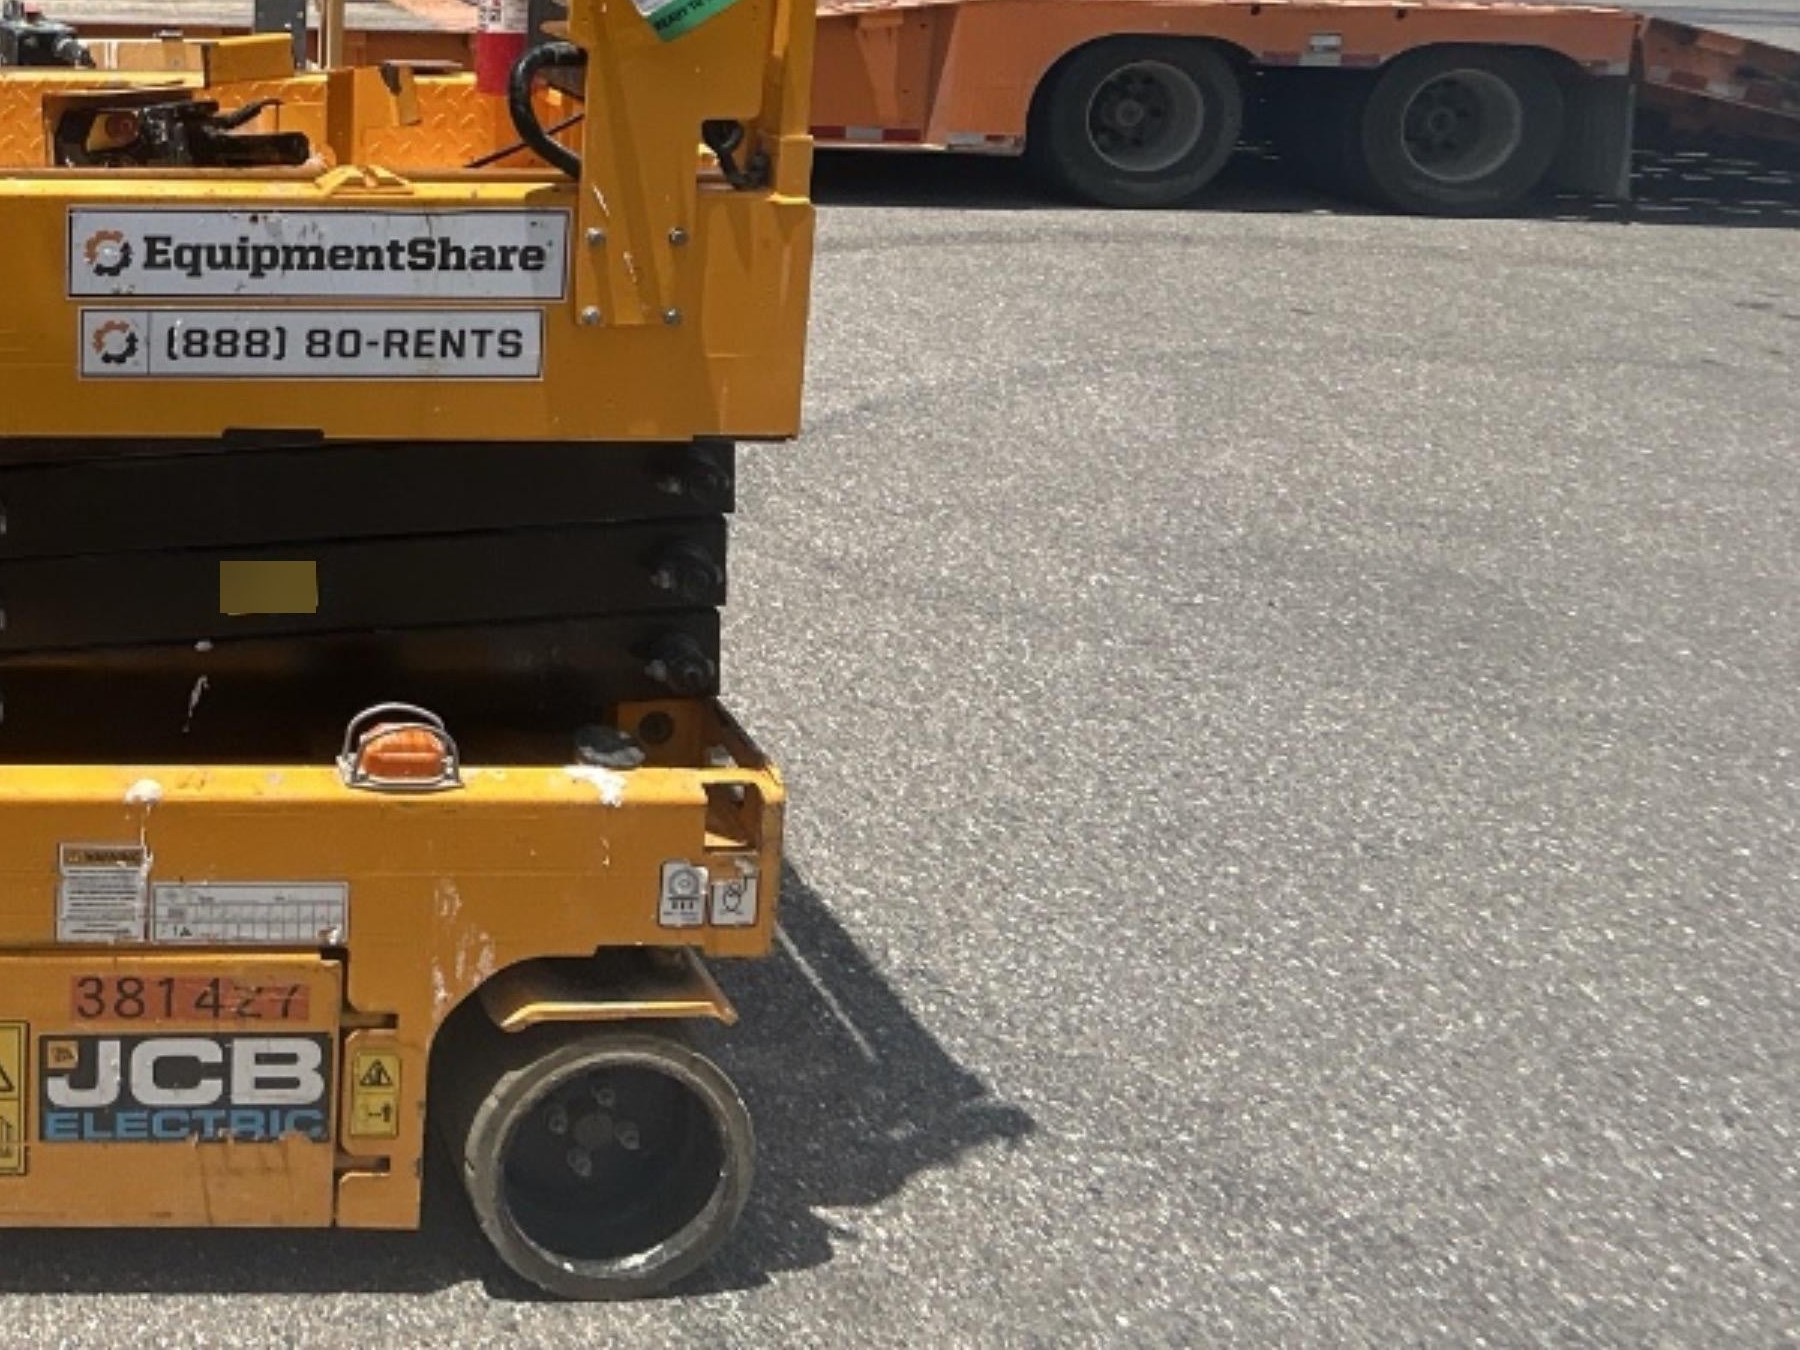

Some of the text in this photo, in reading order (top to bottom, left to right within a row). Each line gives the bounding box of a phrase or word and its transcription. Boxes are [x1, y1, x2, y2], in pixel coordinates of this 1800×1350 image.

[142, 234, 548, 278] EquipmentShare
[166, 326, 525, 360] (888) 80-RENTS
[76, 976, 301, 1020] 381427
[46, 1037, 326, 1108] JCB
[44, 1108, 329, 1140] ELECTRIC
